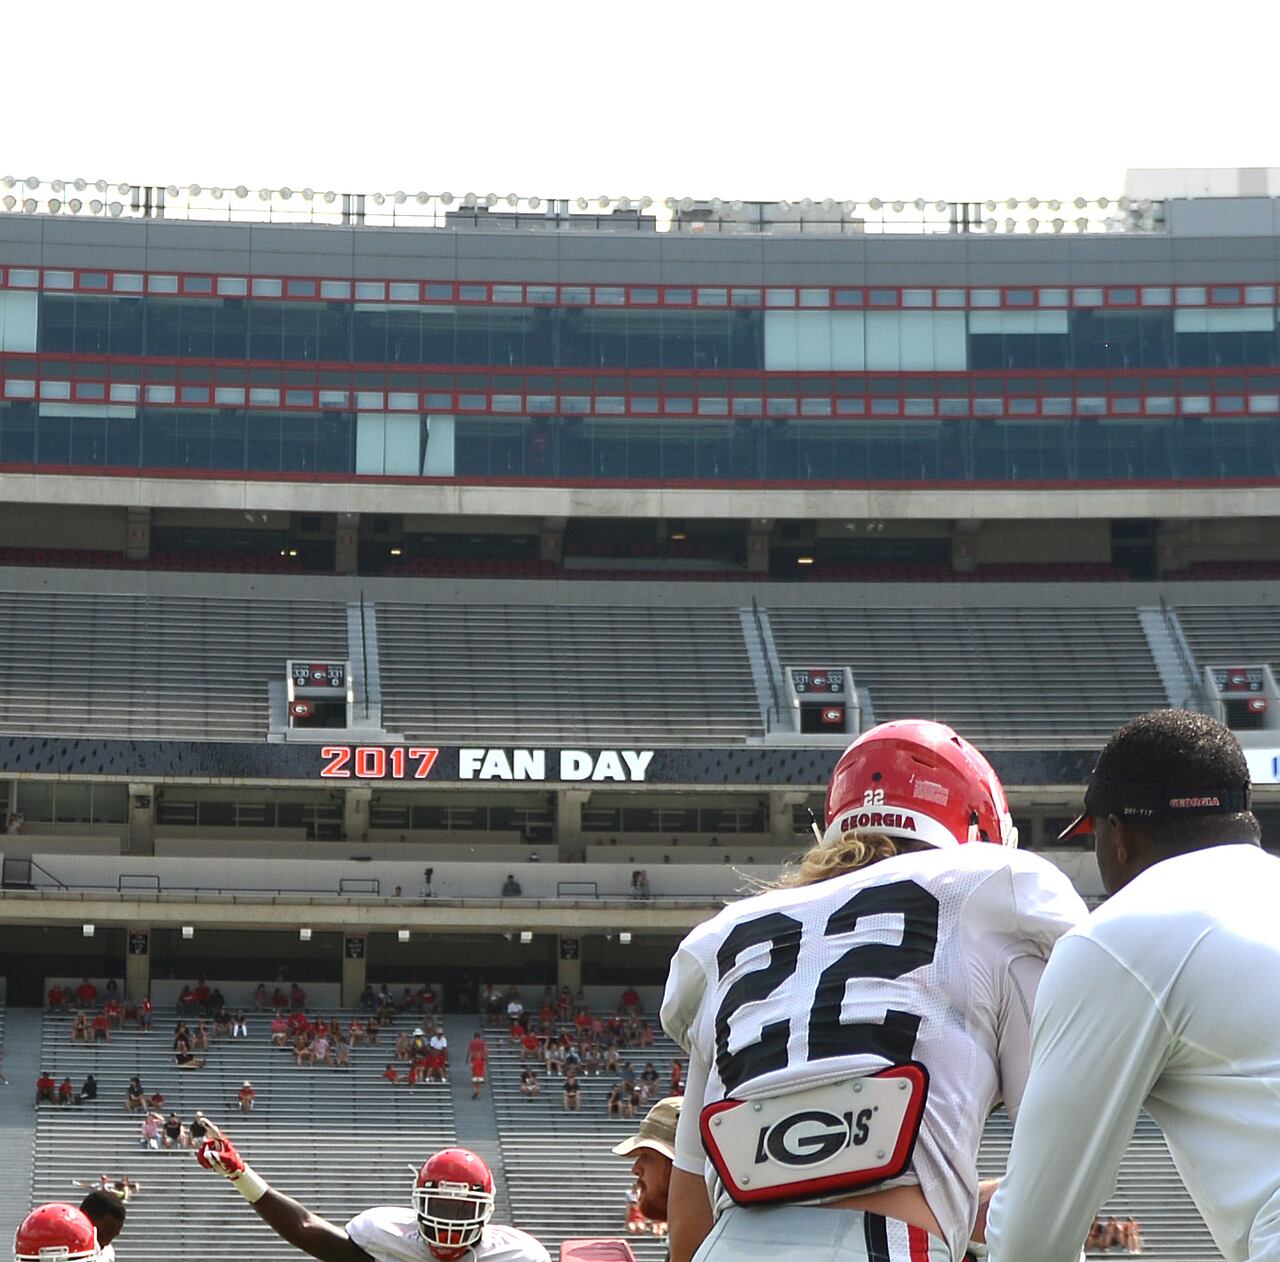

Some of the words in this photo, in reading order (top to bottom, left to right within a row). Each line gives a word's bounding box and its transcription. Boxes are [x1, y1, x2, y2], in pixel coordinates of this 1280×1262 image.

[320, 747, 439, 778] 2017
[459, 749, 545, 780] FAN
[560, 750, 654, 781] DAY
[863, 788, 885, 807] 22
[840, 811, 917, 833] GEORGIA
[716, 880, 940, 1100] 22
